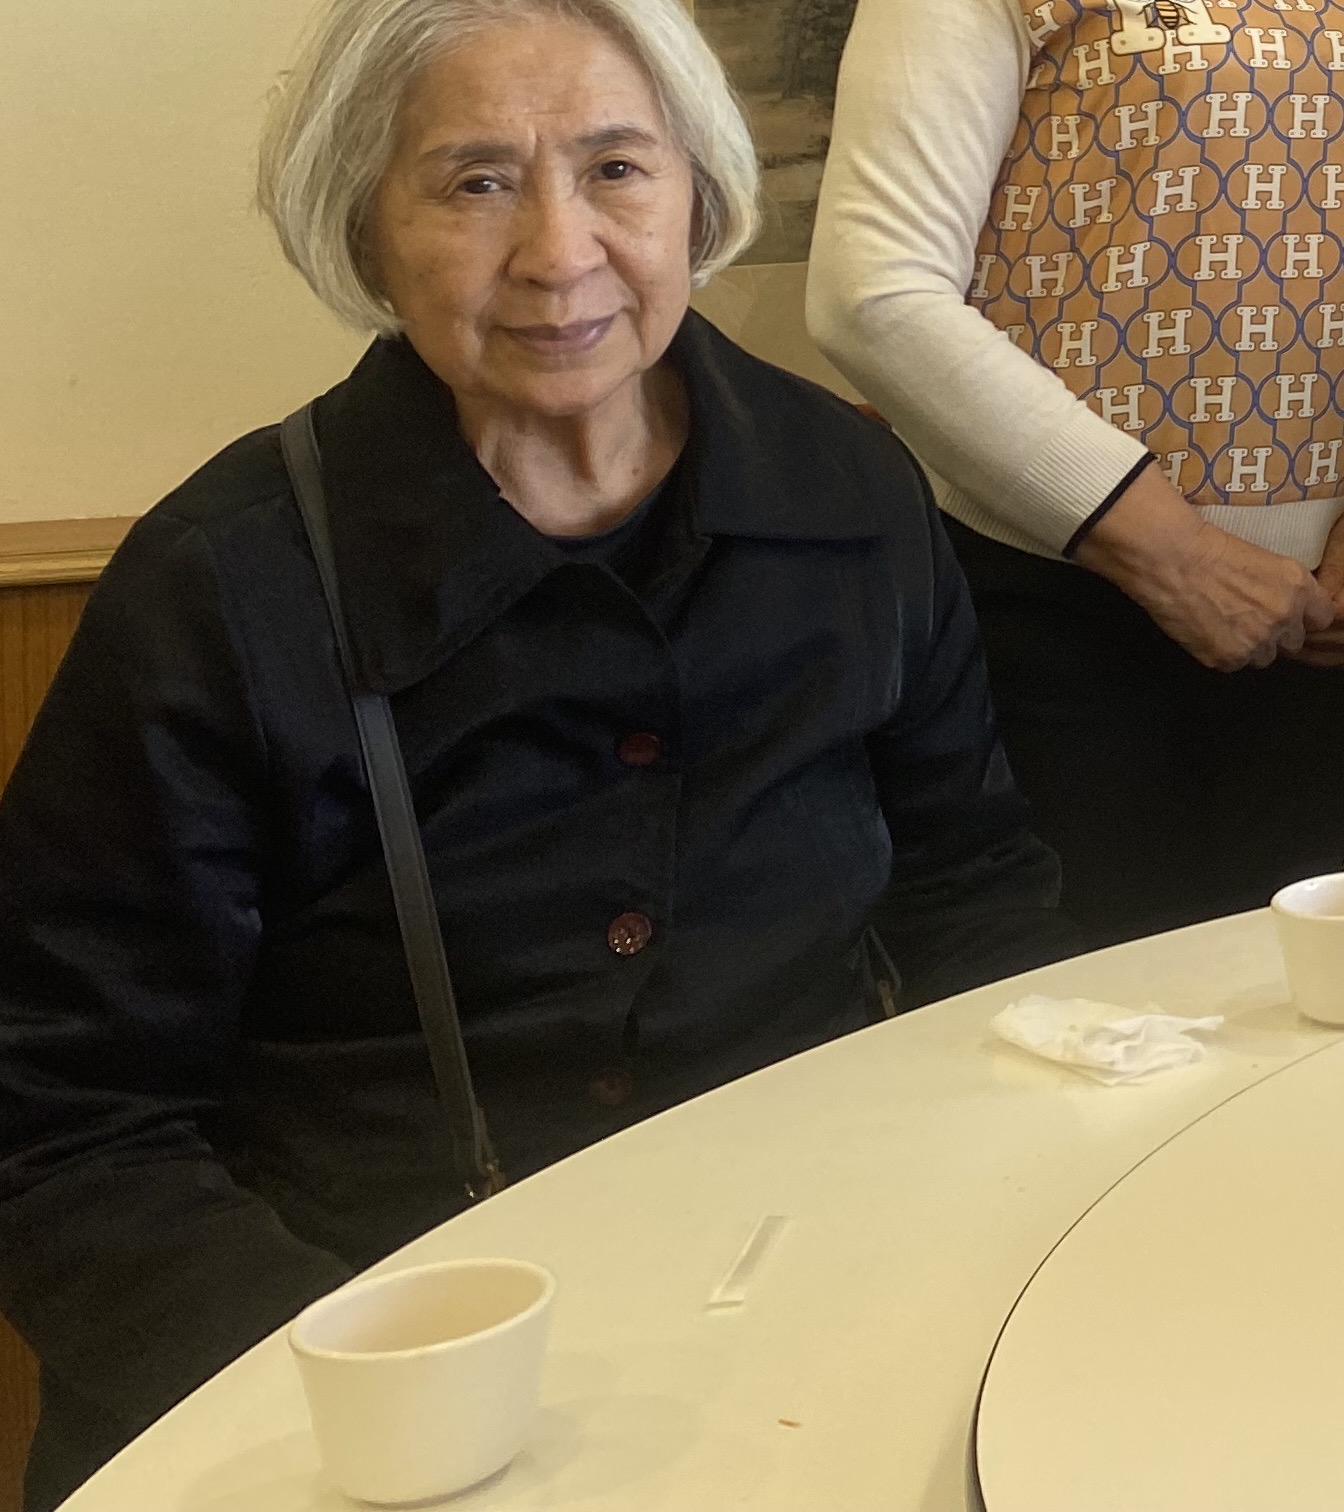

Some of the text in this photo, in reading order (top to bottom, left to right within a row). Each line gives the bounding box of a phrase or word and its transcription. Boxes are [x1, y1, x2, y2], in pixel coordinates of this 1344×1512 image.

[1073, 40, 1117, 90] H
[1245, 26, 1291, 69] H
[1049, 115, 1084, 161] H
[1116, 101, 1165, 152] H
[1203, 93, 1252, 138] H
[1289, 94, 1332, 139] H
[1001, 185, 1042, 230] H
[1069, 179, 1118, 228] H
[1149, 166, 1201, 216] H
[1243, 163, 1287, 210] H
[1026, 252, 1074, 297] H
[1103, 242, 1151, 292] H
[1194, 235, 1245, 280] H
[1282, 234, 1328, 278] H
[1055, 322, 1098, 368] H
[1143, 308, 1193, 358] H
[1236, 306, 1279, 351] H
[1095, 384, 1145, 430] H
[1191, 376, 1238, 422] H
[1276, 374, 1319, 420] H
[1228, 447, 1273, 492] H
[1306, 440, 1343, 486] H
